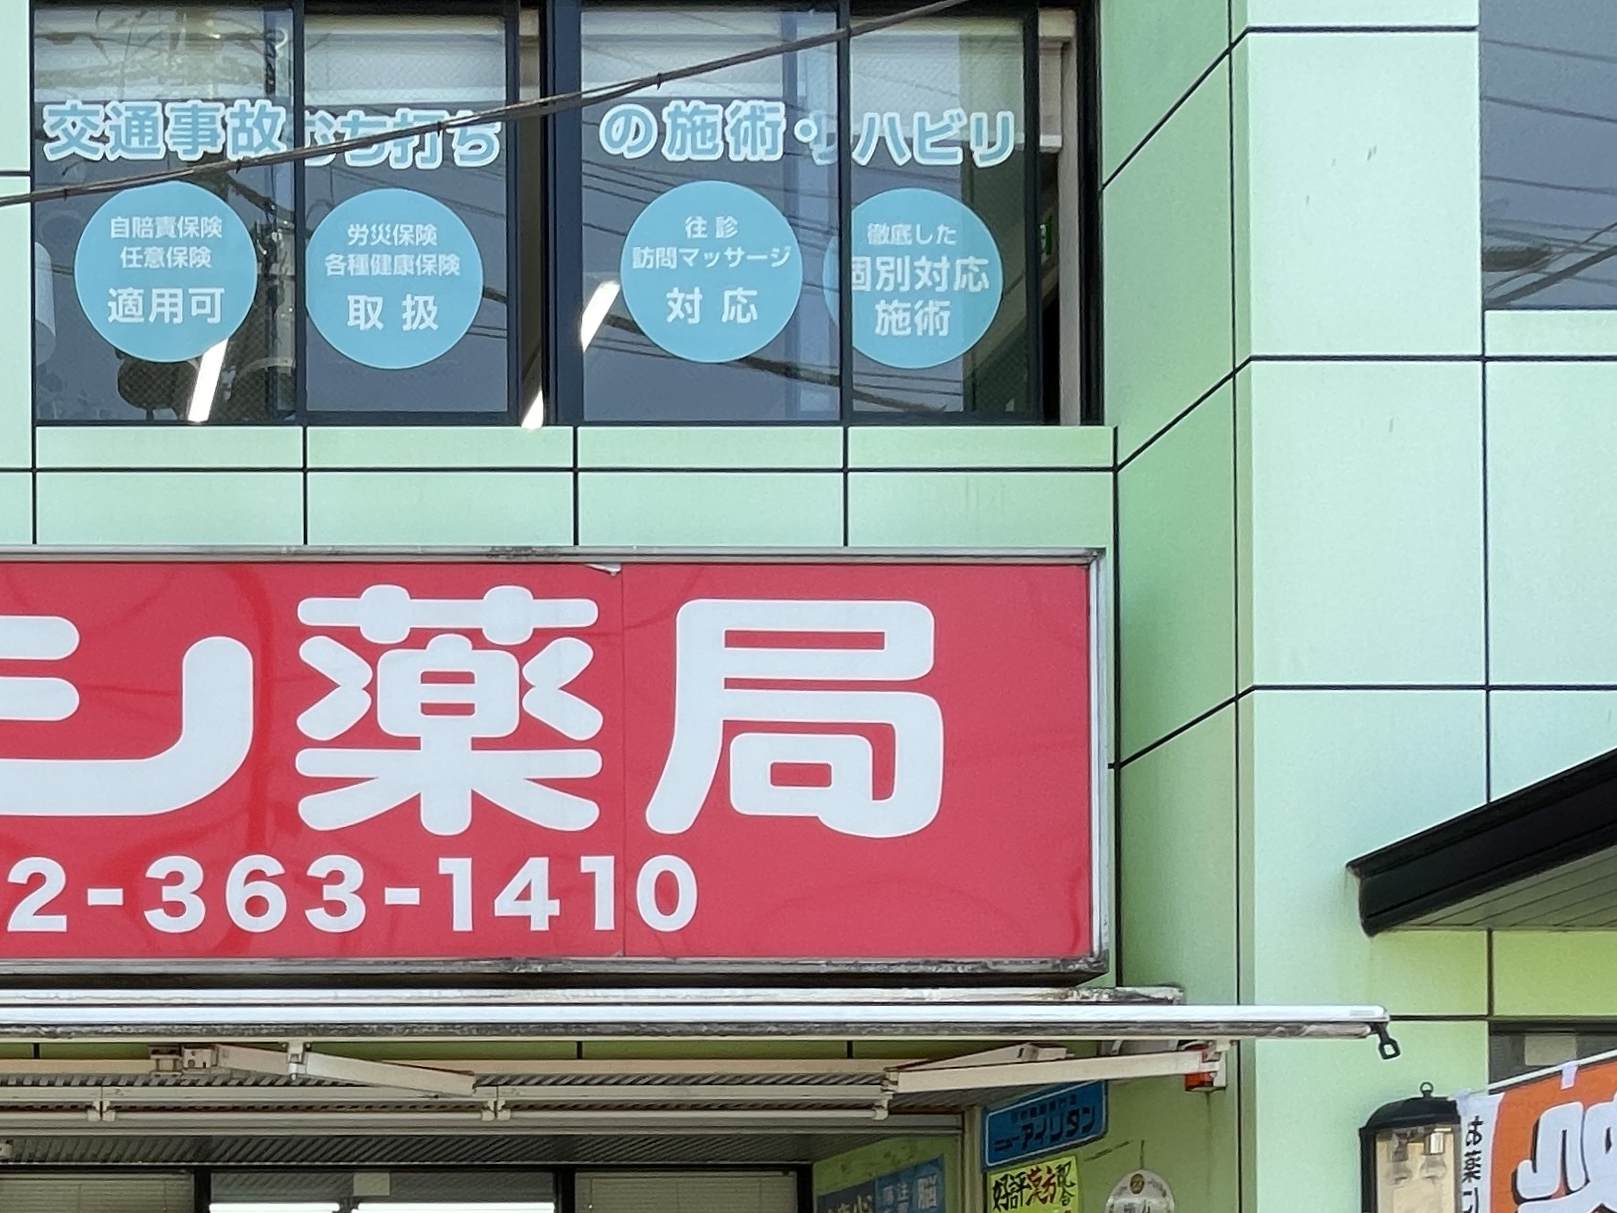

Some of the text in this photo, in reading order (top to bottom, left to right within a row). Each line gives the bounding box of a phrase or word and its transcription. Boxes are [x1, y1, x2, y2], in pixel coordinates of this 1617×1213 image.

[110, 216, 223, 239] 自賠責保険
[347, 223, 438, 247] 労災保険
[685, 216, 739, 239] 往診
[867, 223, 957, 247] 徹底した
[120, 246, 212, 269] 任意保険
[324, 253, 461, 277] 各種健康保険
[632, 246, 792, 270] 訪問マッサージ
[107, 287, 225, 325] 適用可
[874, 300, 951, 338] 施術
